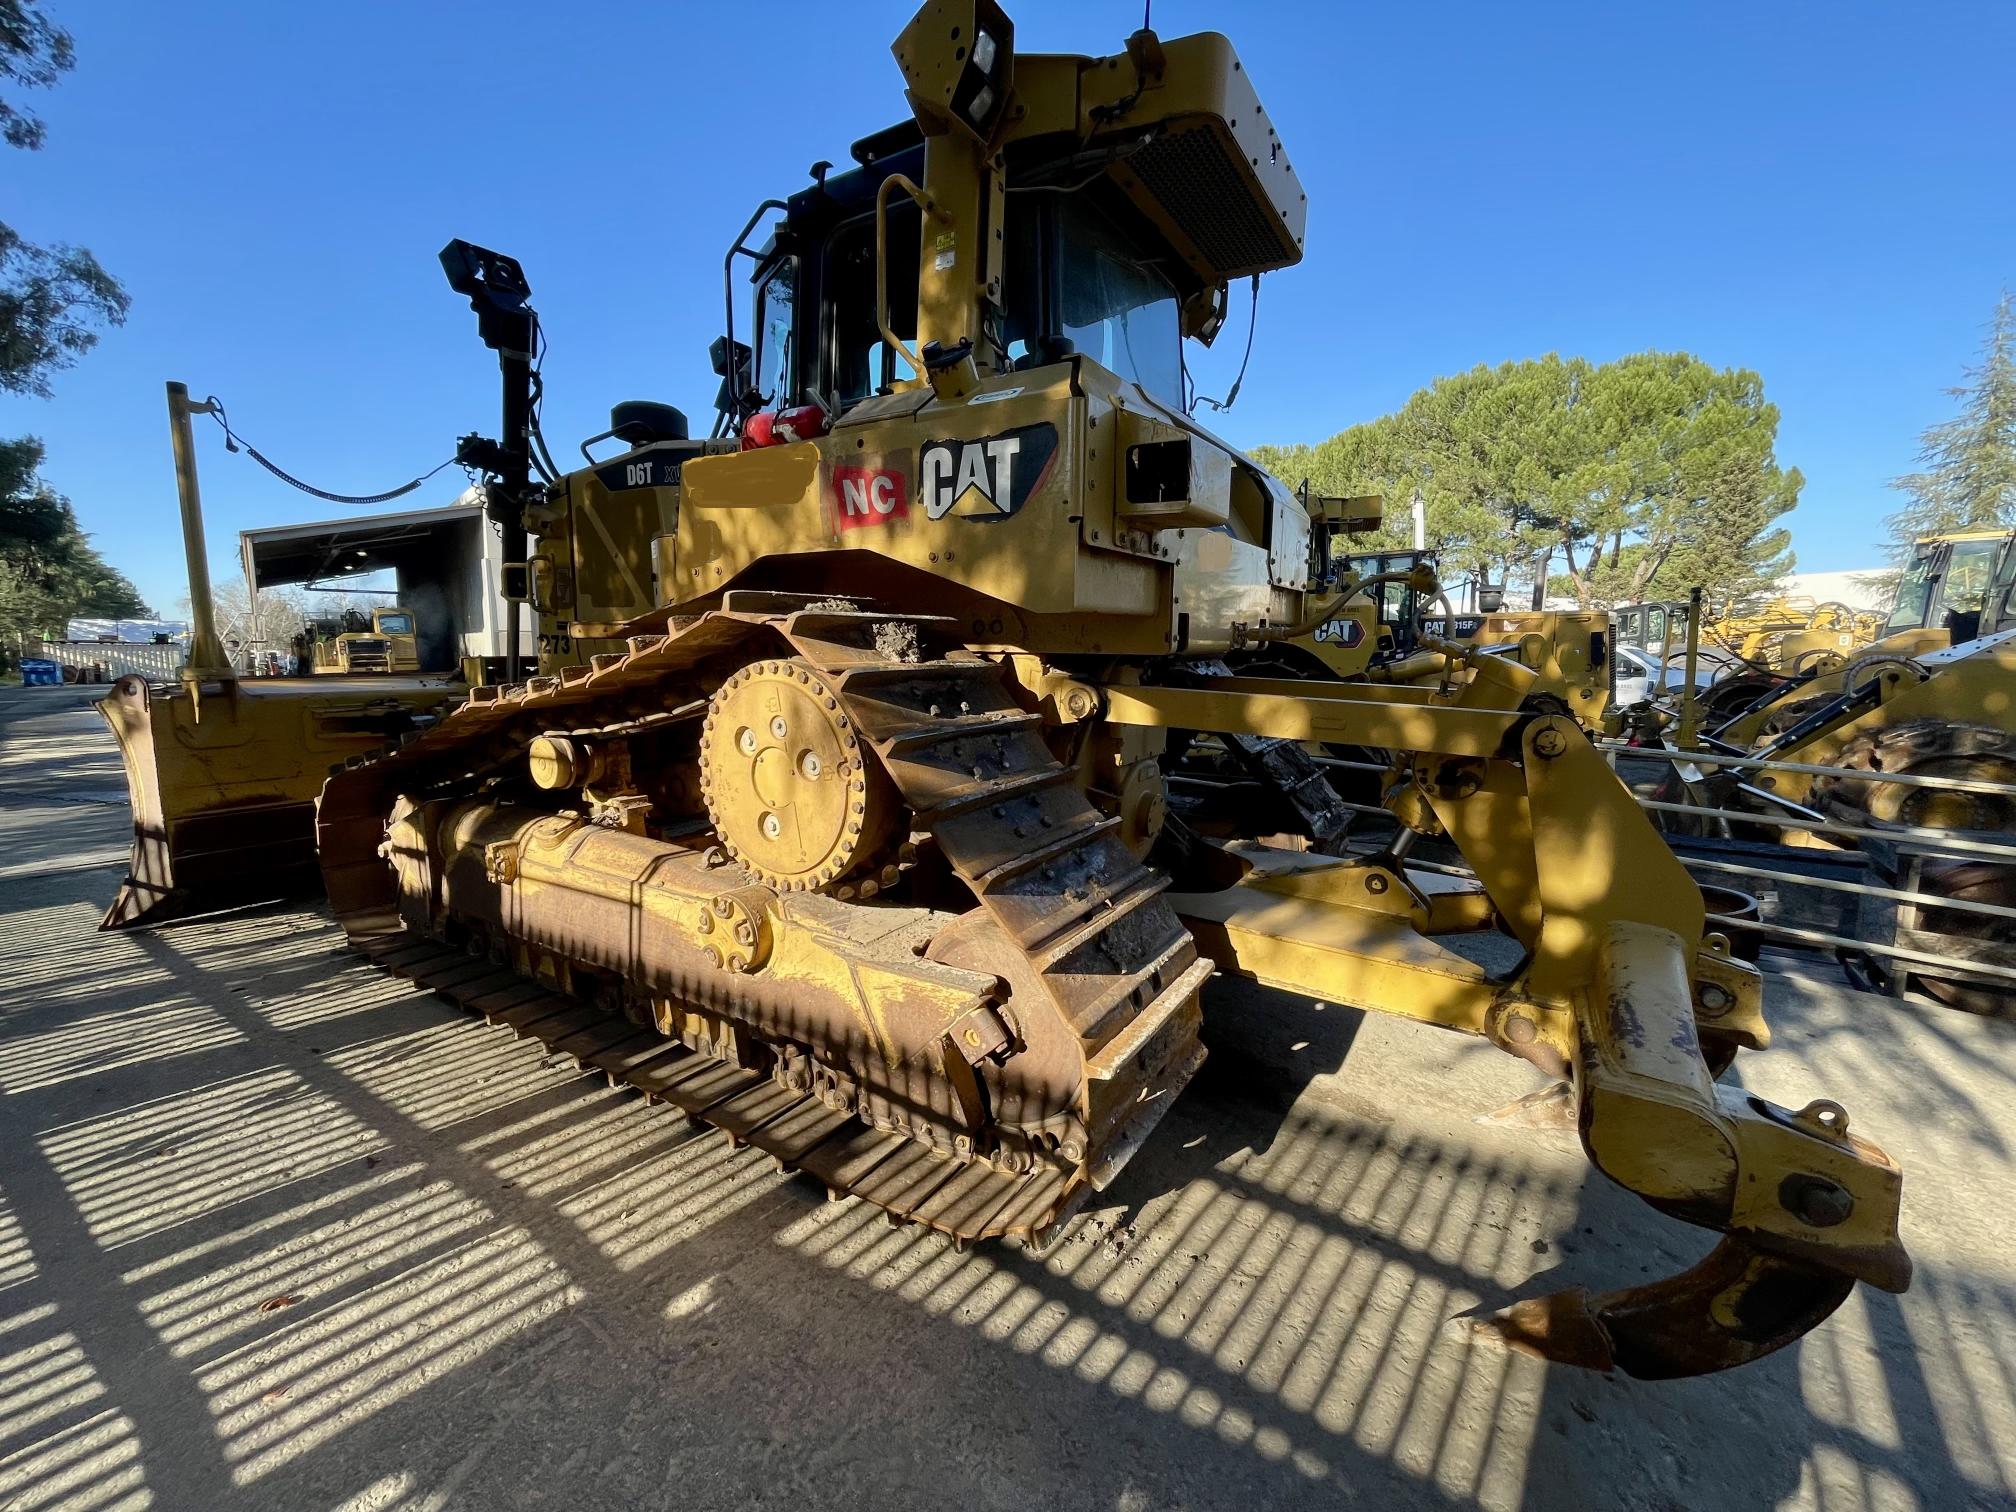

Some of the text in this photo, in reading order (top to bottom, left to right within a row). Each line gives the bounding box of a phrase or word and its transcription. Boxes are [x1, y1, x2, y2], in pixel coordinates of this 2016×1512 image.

[626, 461, 653, 486] D6T
[922, 437, 1020, 519] CAT
[842, 475, 896, 516] NC
[1314, 620, 1353, 642] CAT
[1424, 620, 1446, 635] CAT
[537, 633, 571, 656] 273
